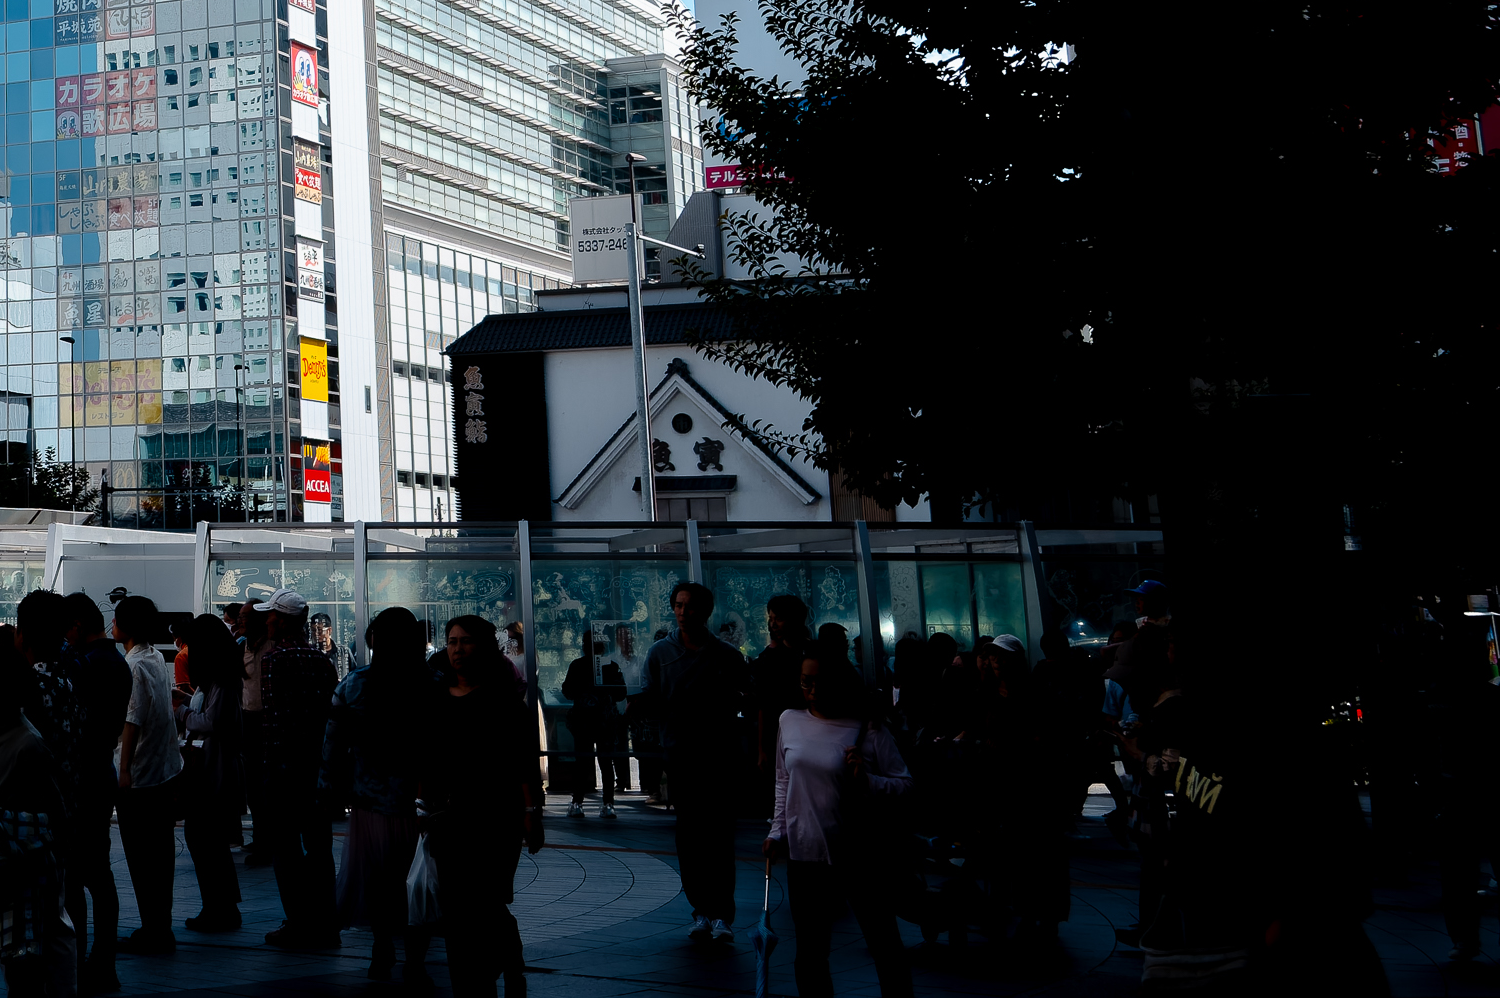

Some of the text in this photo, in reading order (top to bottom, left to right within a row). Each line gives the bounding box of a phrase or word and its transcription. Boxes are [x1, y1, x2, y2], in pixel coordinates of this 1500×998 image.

[56, 15, 103, 37] 平城苑
[59, 72, 155, 104] カラオケ
[82, 102, 156, 134] 歌広場
[83, 170, 149, 196] 山内農場
[297, 171, 322, 190] 食べ放題
[108, 209, 159, 228] 食べ放題
[62, 271, 73, 280] 4F
[301, 357, 327, 380] Denny's
[66, 368, 156, 413] Denny's
[91, 411, 125, 420] レストラン
[306, 479, 330, 494] ACCEA
